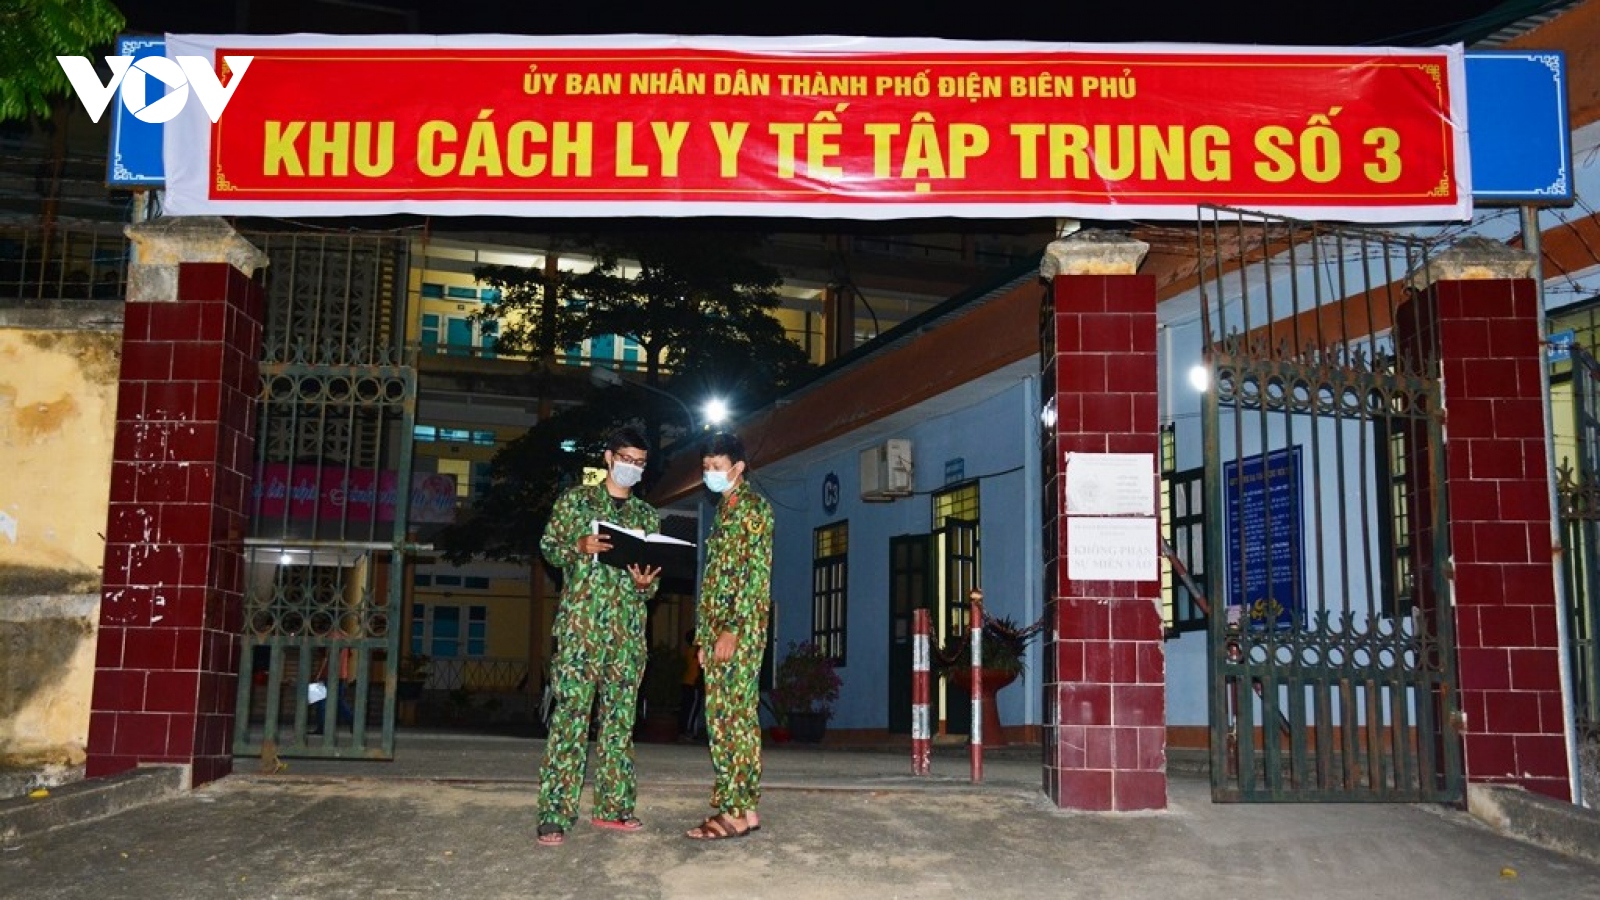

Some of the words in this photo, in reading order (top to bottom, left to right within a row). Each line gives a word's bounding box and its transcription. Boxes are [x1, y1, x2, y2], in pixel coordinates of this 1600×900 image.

[523, 63, 558, 94] ỦY
[565, 73, 621, 95] BAN
[629, 68, 706, 95] NHÂN
[713, 69, 770, 96] DÂN
[778, 71, 868, 97] THÀNH
[876, 69, 931, 97] PHỐ
[938, 71, 1002, 103] ĐIỆN
[1010, 72, 1074, 98] BIÊN
[1082, 68, 1137, 99] PHỦ
[263, 119, 395, 178] KHU
[416, 108, 593, 178] CÁCH
[615, 121, 690, 178] LY
[710, 121, 749, 178] Y
[768, 102, 850, 181] TẾ
[864, 111, 990, 194] TẬP
[1010, 124, 1232, 182] TRUNG
[1254, 106, 1343, 184] SỐ
[1363, 127, 1402, 184] 3
